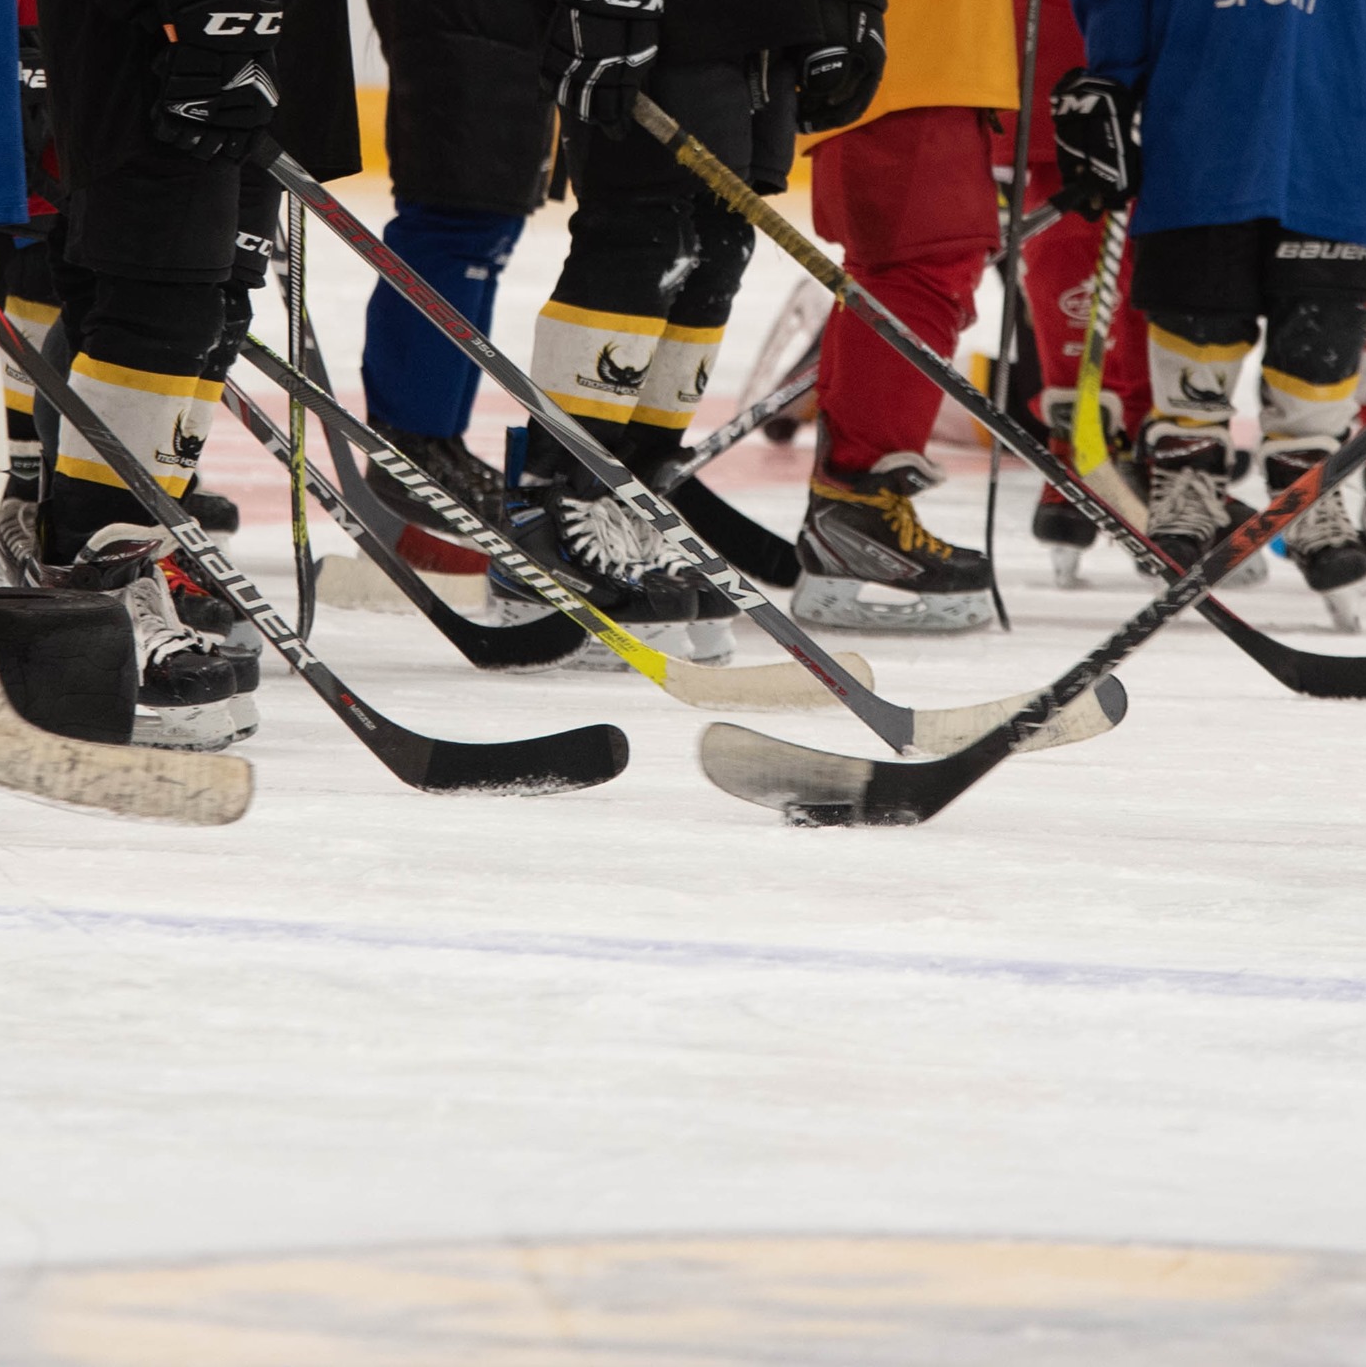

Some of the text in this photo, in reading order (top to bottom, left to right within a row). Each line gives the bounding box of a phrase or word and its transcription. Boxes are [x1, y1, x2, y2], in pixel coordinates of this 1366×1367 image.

[810, 61, 843, 76] CCM
[302, 192, 497, 359] JETSPEED 350
[171, 520, 324, 670] BAUER
[367, 448, 585, 612] WARRIOR
[615, 481, 769, 611] CCM
